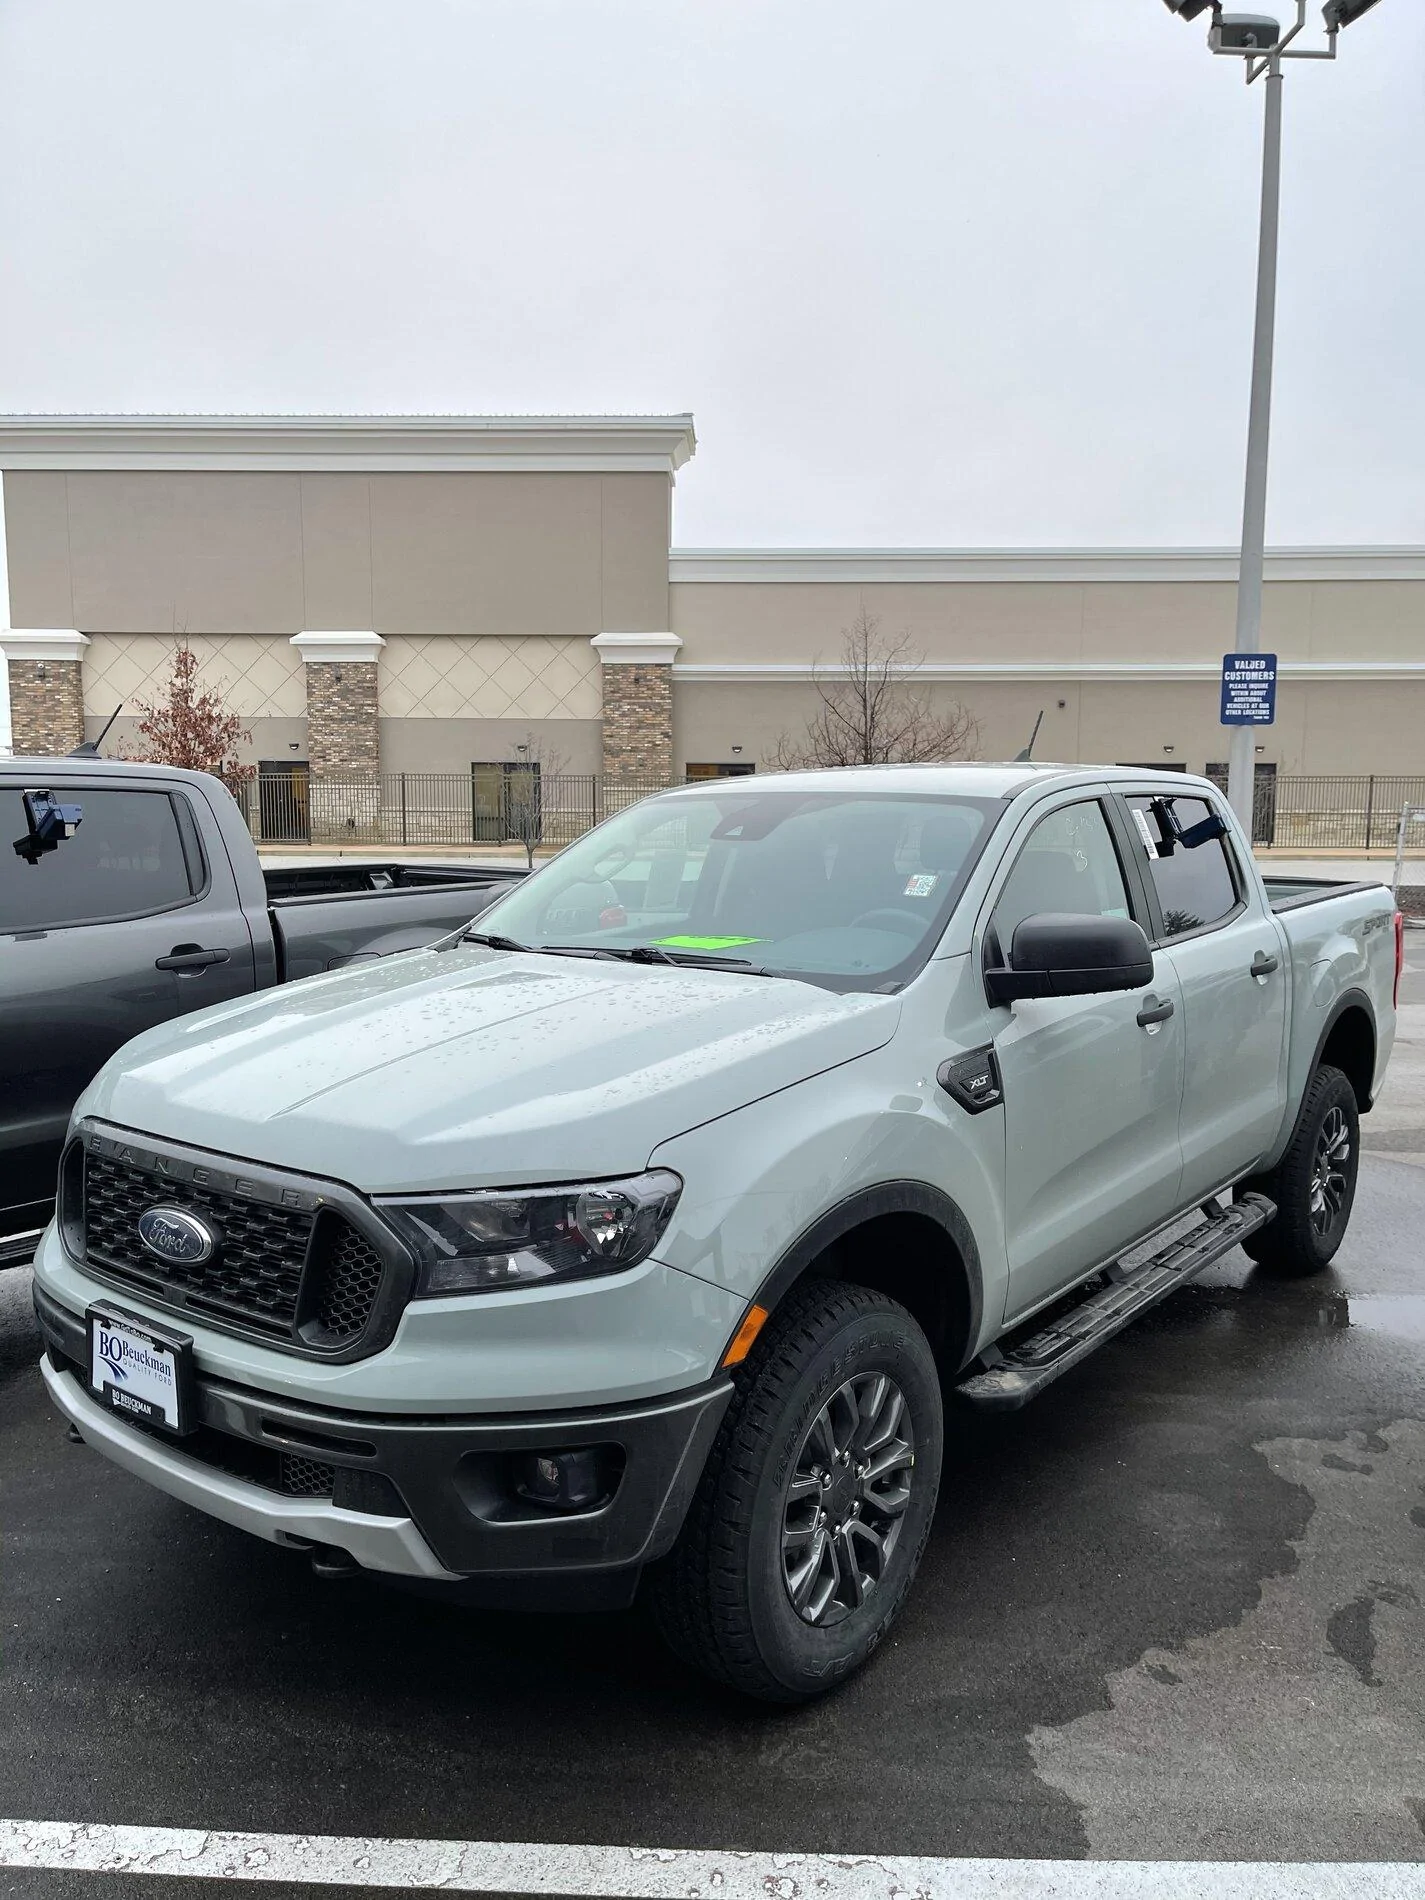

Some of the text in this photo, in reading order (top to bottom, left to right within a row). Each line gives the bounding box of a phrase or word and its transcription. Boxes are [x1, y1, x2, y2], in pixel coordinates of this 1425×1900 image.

[1224, 671, 1275, 680] CUSTOMERS
[1234, 660, 1266, 669] VALUED
[970, 1074, 989, 1090] XLT
[90, 1136, 301, 1207] RANGER
[148, 1216, 189, 1253] Ford
[122, 1340, 171, 1377] Beuckman
[122, 1357, 172, 1386] QUALITY FORD
[112, 1388, 120, 1400] BO
[120, 1393, 152, 1415] BEUCKMAN
